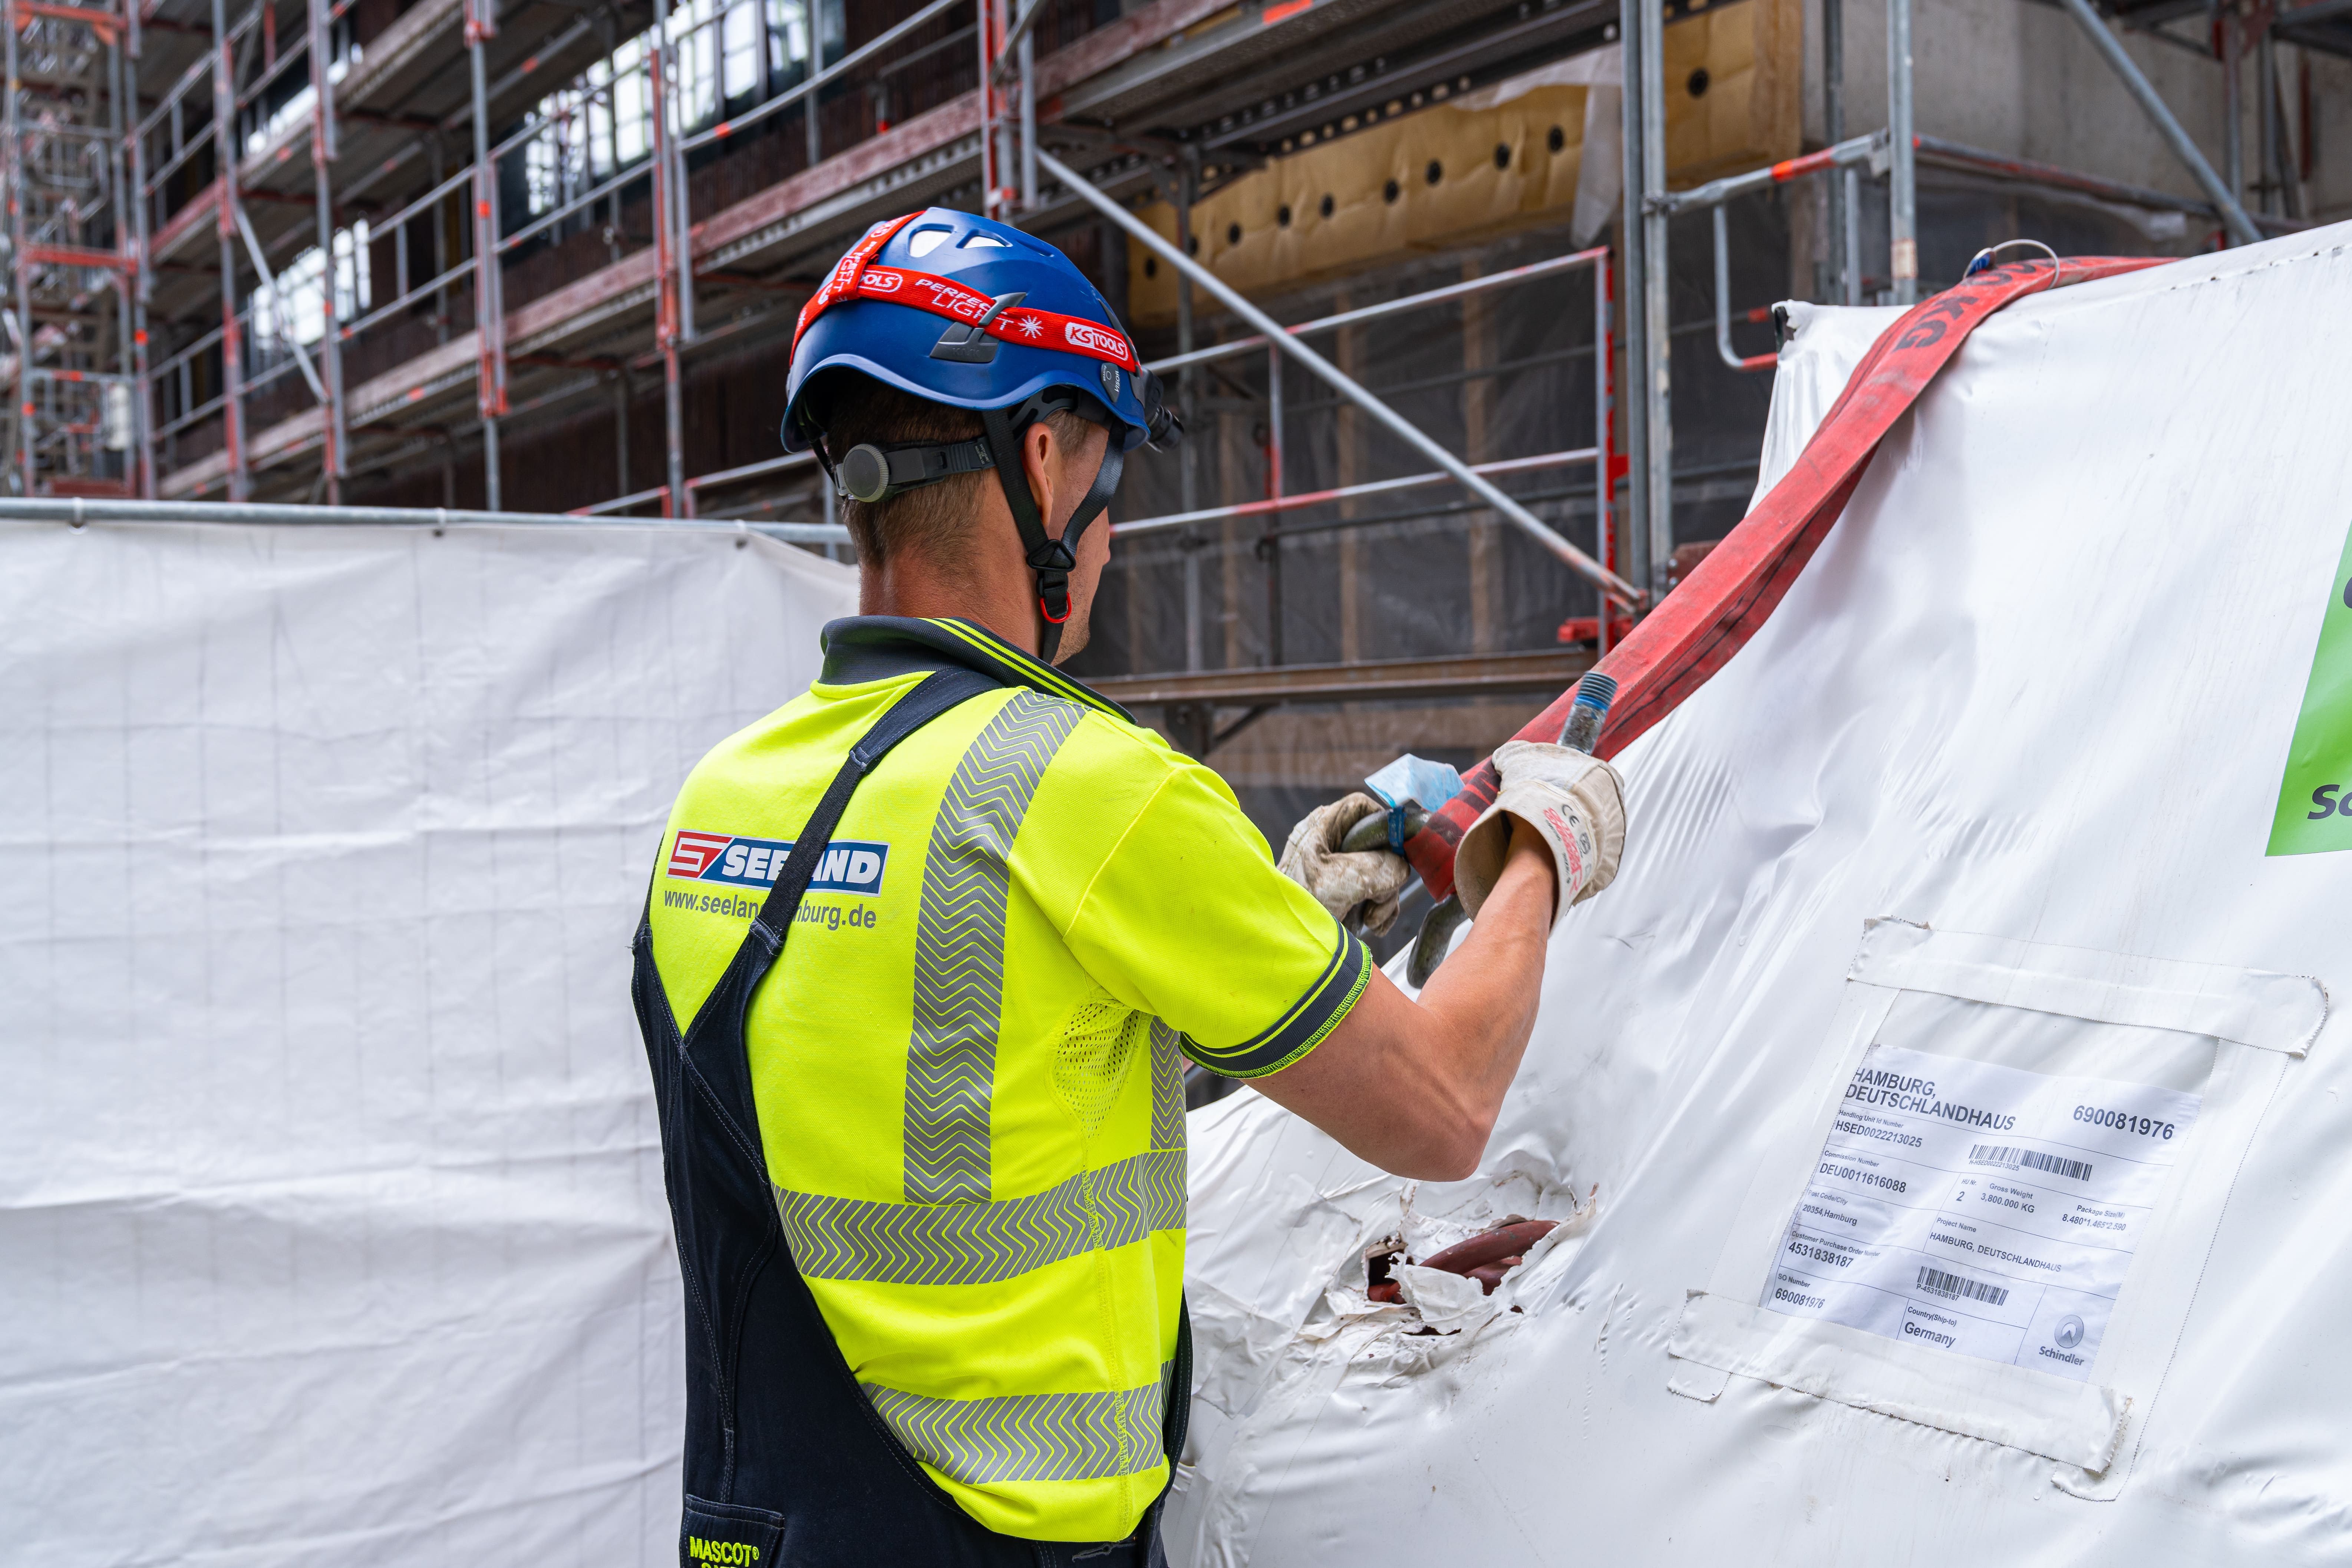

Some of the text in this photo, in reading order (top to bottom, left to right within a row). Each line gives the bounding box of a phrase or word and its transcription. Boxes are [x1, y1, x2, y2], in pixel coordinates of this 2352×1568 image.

[860, 274, 897, 288] OLS
[1093, 333, 1126, 355] TOOLS
[722, 845, 881, 884] SEEAND
[1853, 1068, 1936, 1099] HAMBURG,
[1845, 1084, 2016, 1130] DEUTSCHLANDHAUS
[1839, 1109, 1863, 1121] Handling
[1882, 1119, 1903, 1129] Number
[2073, 1105, 2175, 1140] 690081976
[1835, 1120, 1923, 1148] HSED0022213025
[1824, 1151, 1879, 1168] Commission Number
[1969, 1159, 2020, 1171] H-HSED0022213025
[1820, 1163, 1907, 1193] DEU0011616088
[1820, 1192, 1848, 1205] Code/City
[1956, 1191, 1965, 1202] 2
[1989, 1183, 2033, 1200] Gross Weight
[1980, 1192, 2035, 1213] 3,800.000 KG
[2076, 1205, 2126, 1219] Package Size(M)
[1802, 1204, 1858, 1227] 20354,Hamburg
[1936, 1217, 1977, 1233] Project Name
[1792, 1230, 1819, 1243] Customer
[1819, 1238, 1847, 1251] Purchase
[1848, 1247, 1864, 1255] Order
[1929, 1232, 2062, 1272] HAMBURG, DEUTSCHLANDHAUS
[1788, 1241, 1854, 1268] 4531838187
[1788, 1276, 1811, 1288] Number
[1916, 1284, 1959, 1301] P-4531838187
[1775, 1288, 1825, 1309] 690081976
[1908, 1306, 1957, 1327] Country(Ship-to)
[1904, 1321, 1956, 1348] Germany
[2039, 1346, 2084, 1366] Schindler
